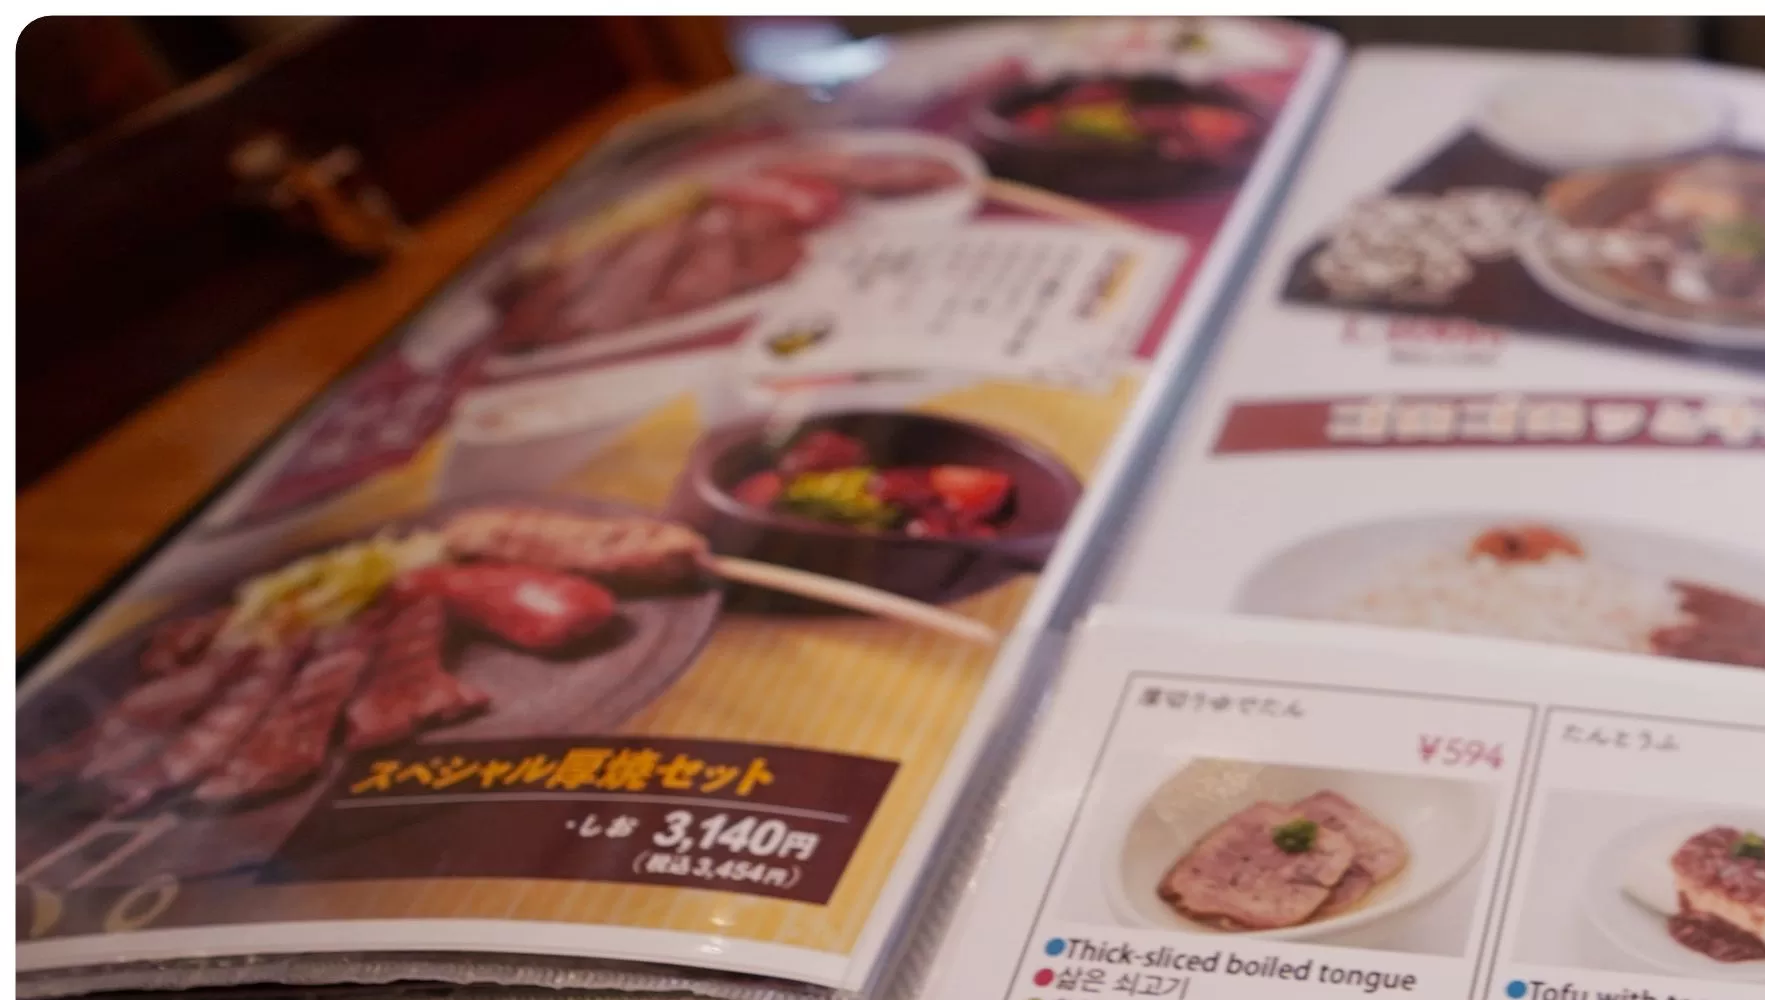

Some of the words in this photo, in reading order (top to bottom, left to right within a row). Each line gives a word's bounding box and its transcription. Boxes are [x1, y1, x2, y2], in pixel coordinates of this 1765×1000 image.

[351, 746, 776, 796] スペシャル厚焼セット
[1416, 733, 1505, 770] ¥594
[653, 810, 822, 862] 3,140円
[1055, 965, 1106, 994] 삶은
[1112, 971, 1190, 1000] 쇠고기
[1067, 938, 1220, 973] Thick-sliced
[1226, 947, 1311, 981] boiled
[1318, 960, 1418, 993] tongue
